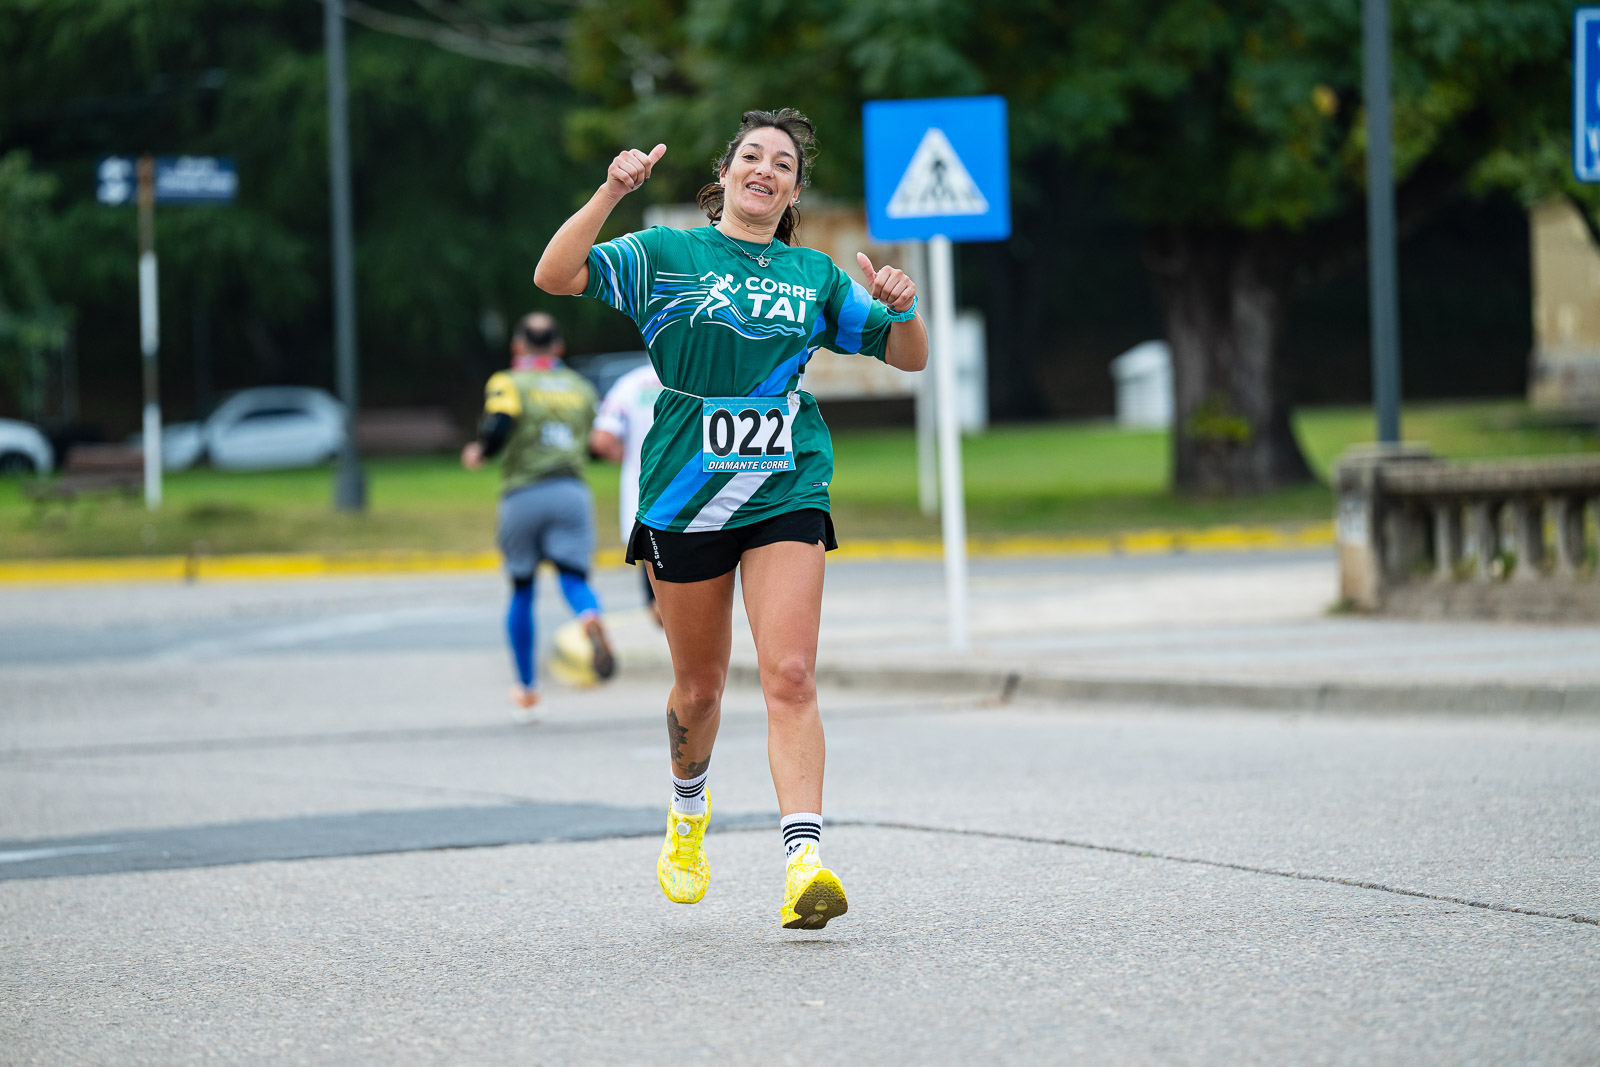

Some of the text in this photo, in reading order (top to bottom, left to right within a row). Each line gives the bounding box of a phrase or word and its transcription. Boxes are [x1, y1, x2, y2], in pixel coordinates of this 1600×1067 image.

[744, 276, 817, 302] CORRE
[747, 293, 807, 324] TAI
[708, 408, 786, 458] 022
[707, 460, 790, 470] DIAMANTE CORRE
